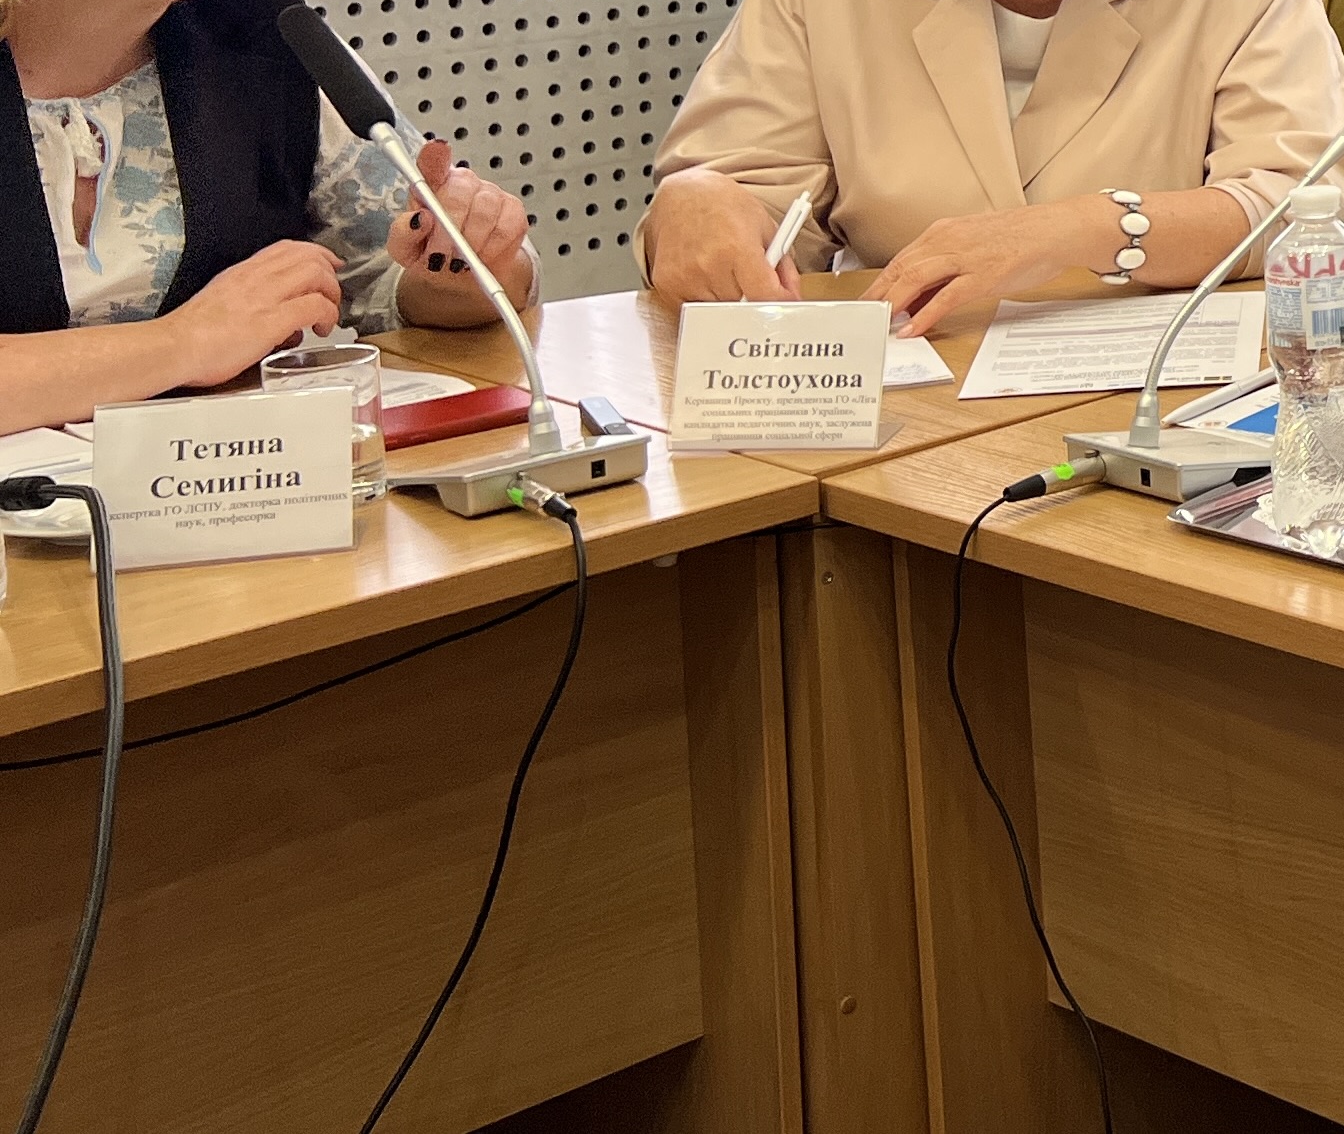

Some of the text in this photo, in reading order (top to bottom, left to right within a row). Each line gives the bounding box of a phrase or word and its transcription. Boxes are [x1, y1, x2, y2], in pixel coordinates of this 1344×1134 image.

[728, 337, 844, 358] Світлана
[703, 370, 862, 393] Толстоухова
[835, 396, 849, 404] ГО
[170, 437, 283, 462] Тетяна
[151, 468, 302, 499] Семигіна
[108, 508, 160, 522] кспертка
[164, 506, 181, 516] ГО
[229, 498, 281, 511] докторка
[284, 492, 348, 505] політичних
[175, 512, 276, 529] наук, професорка
